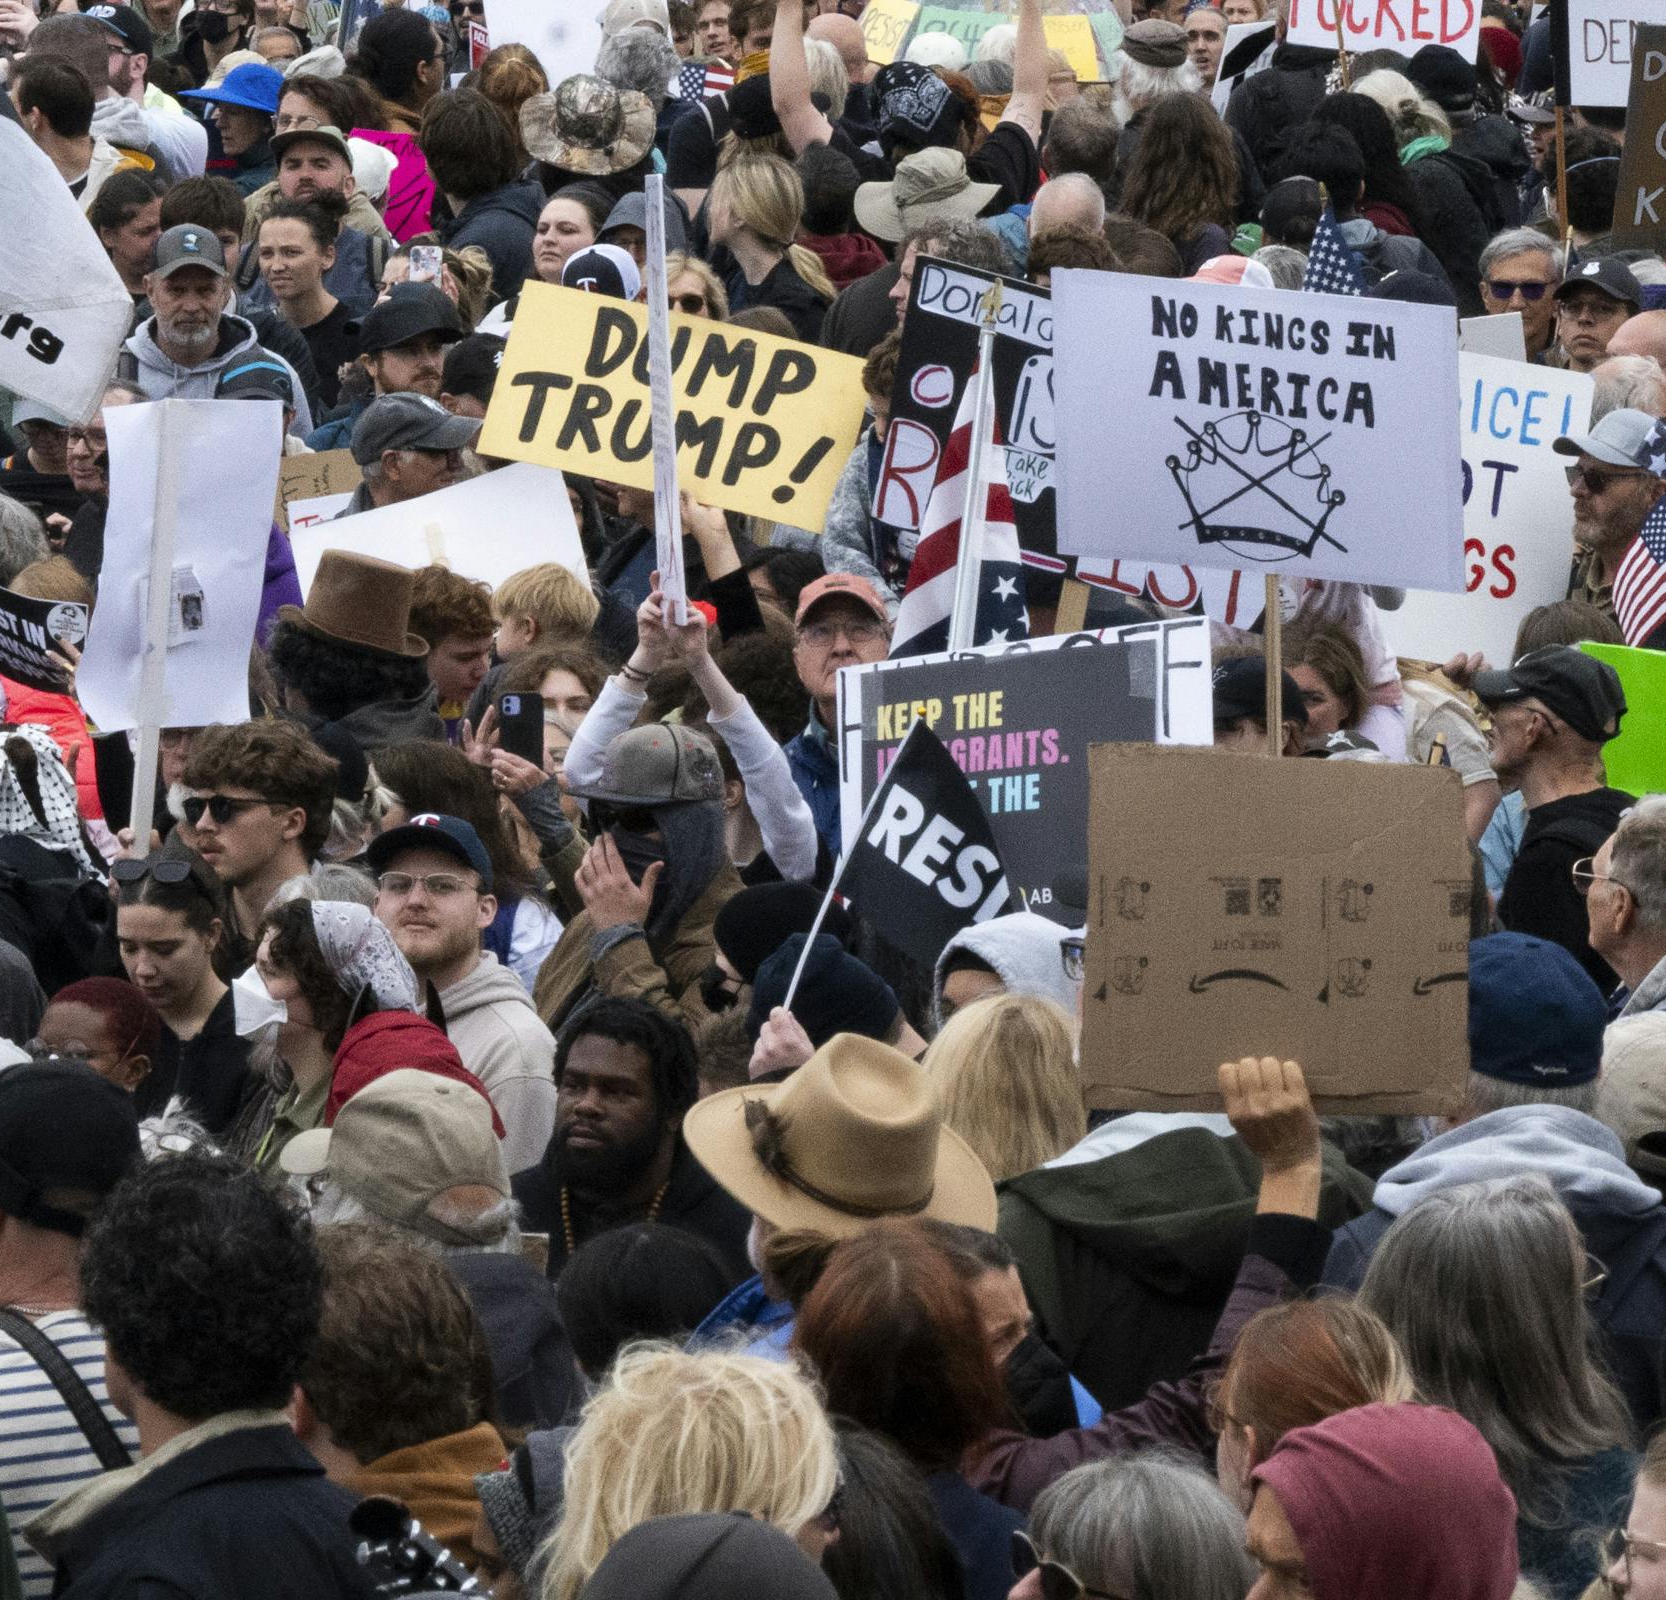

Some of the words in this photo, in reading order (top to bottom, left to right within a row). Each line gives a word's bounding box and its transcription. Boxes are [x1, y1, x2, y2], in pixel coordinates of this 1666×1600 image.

[585, 306, 816, 417] DUMP
[1152, 295, 1198, 339] NO
[1215, 305, 1330, 355] KINGS
[1345, 321, 1396, 361] IN
[1148, 350, 1375, 429] AMERICA
[510, 372, 836, 505] TRUMP!
